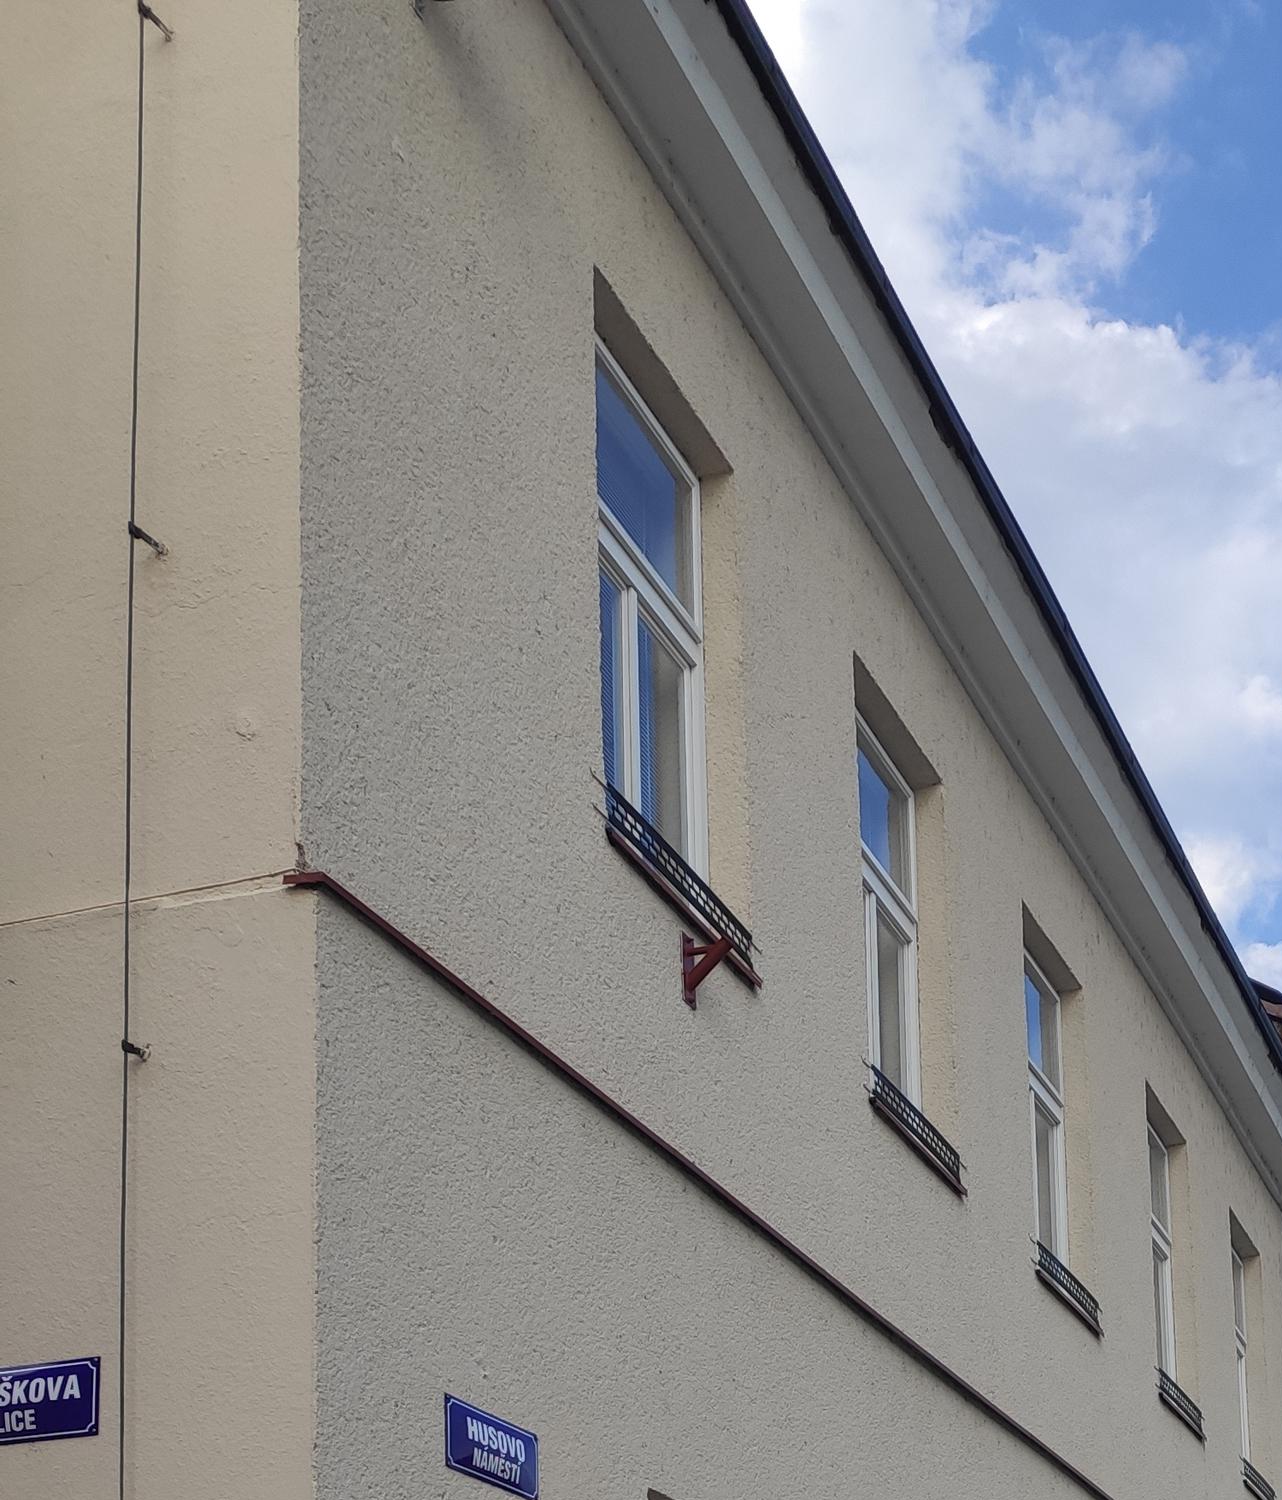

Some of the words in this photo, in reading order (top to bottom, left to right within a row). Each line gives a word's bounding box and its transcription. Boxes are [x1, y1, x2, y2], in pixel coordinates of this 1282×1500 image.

[0, 1374, 81, 1407] ŠKOVA
[466, 1416, 526, 1463] HUSOVO
[472, 1446, 522, 1485] NÁMĚSTÍ
